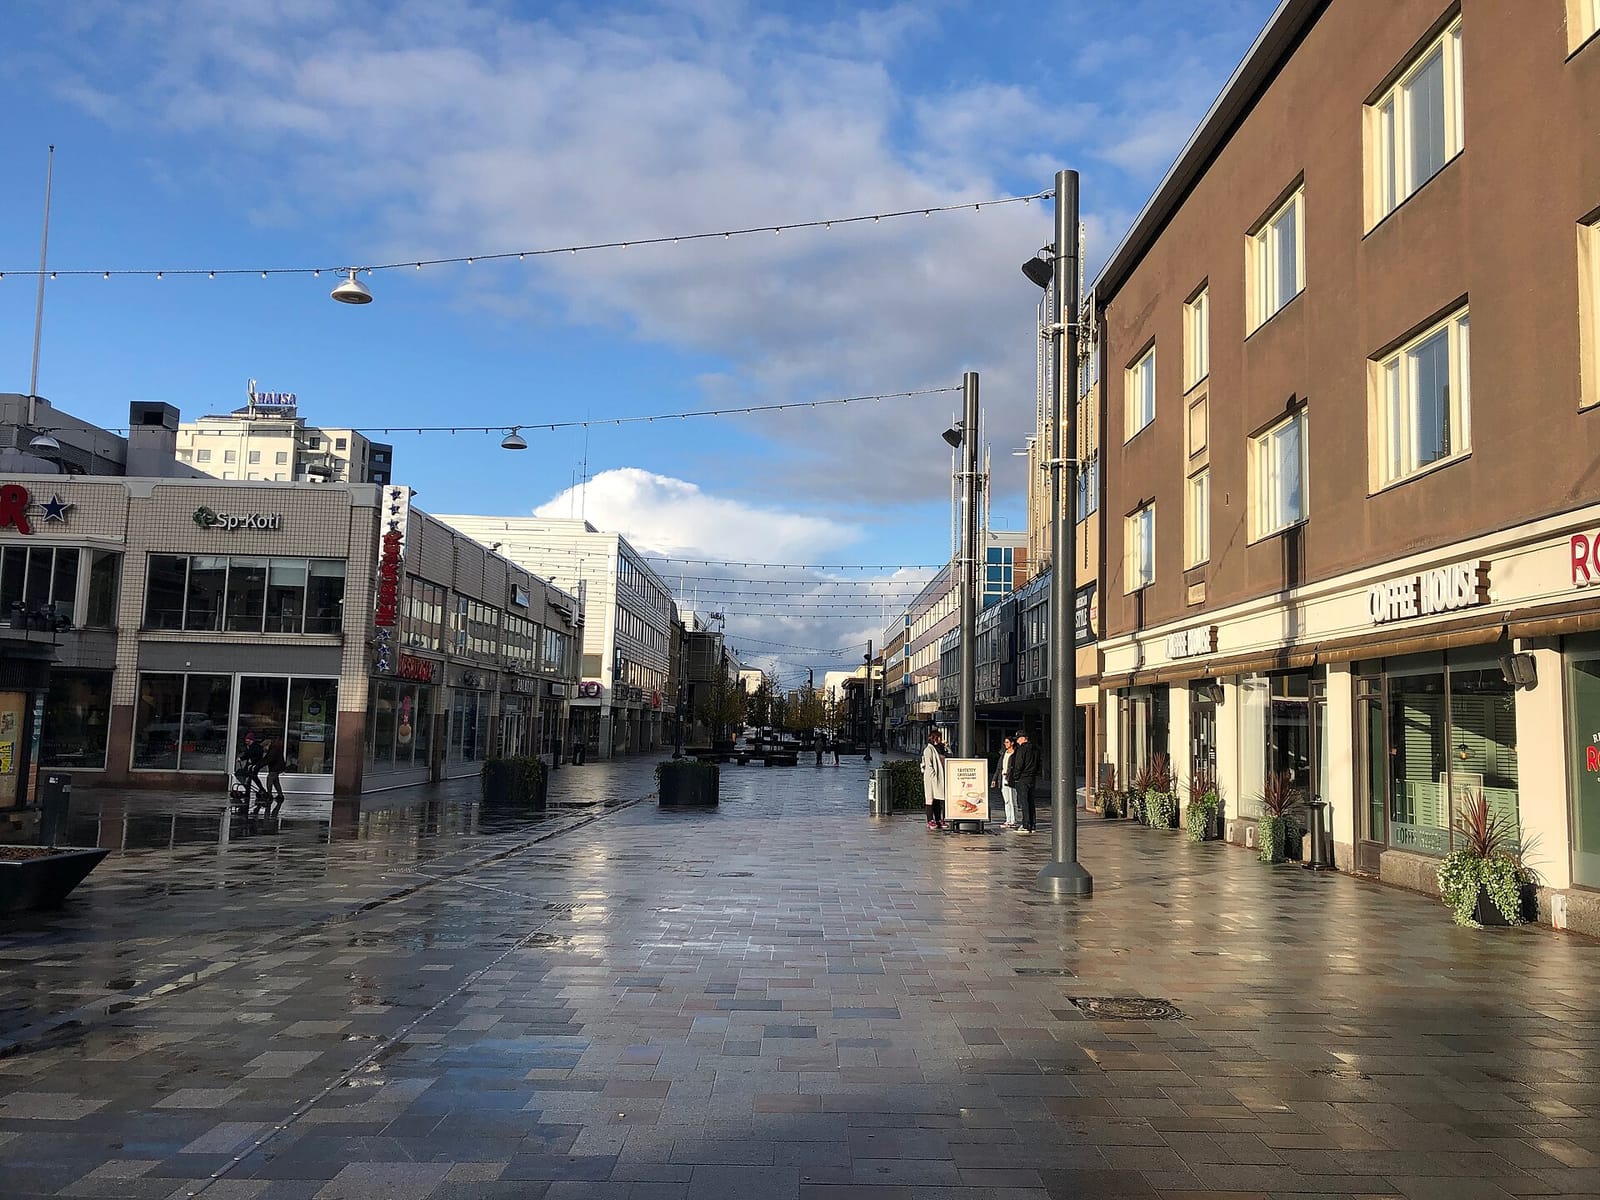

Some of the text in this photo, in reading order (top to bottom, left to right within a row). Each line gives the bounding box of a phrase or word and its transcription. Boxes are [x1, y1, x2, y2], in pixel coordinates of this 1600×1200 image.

[217, 512, 280, 531] Sp-Koti
[1368, 560, 1480, 622] COFFEE HOUSE
